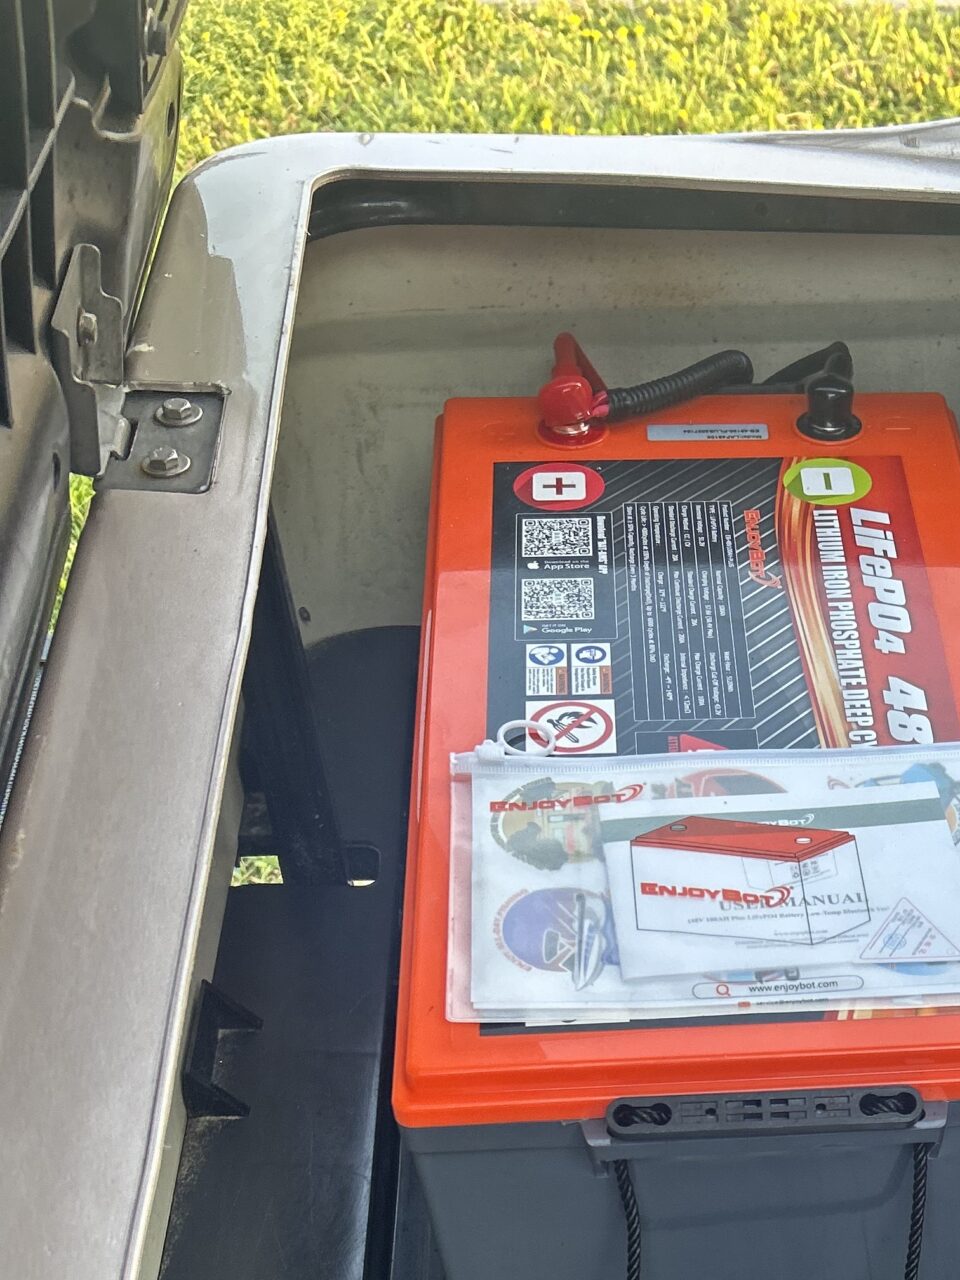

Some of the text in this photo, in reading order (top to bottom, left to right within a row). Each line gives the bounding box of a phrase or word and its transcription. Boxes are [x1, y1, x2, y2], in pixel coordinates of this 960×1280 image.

[813, 509, 846, 563] LITHIUM
[822, 565, 853, 599] IRON
[574, 626, 593, 634] Play
[828, 601, 867, 693] PHOSPHATE
[843, 689, 874, 729] DEEP
[748, 981, 838, 993] www.enjoybot.com
